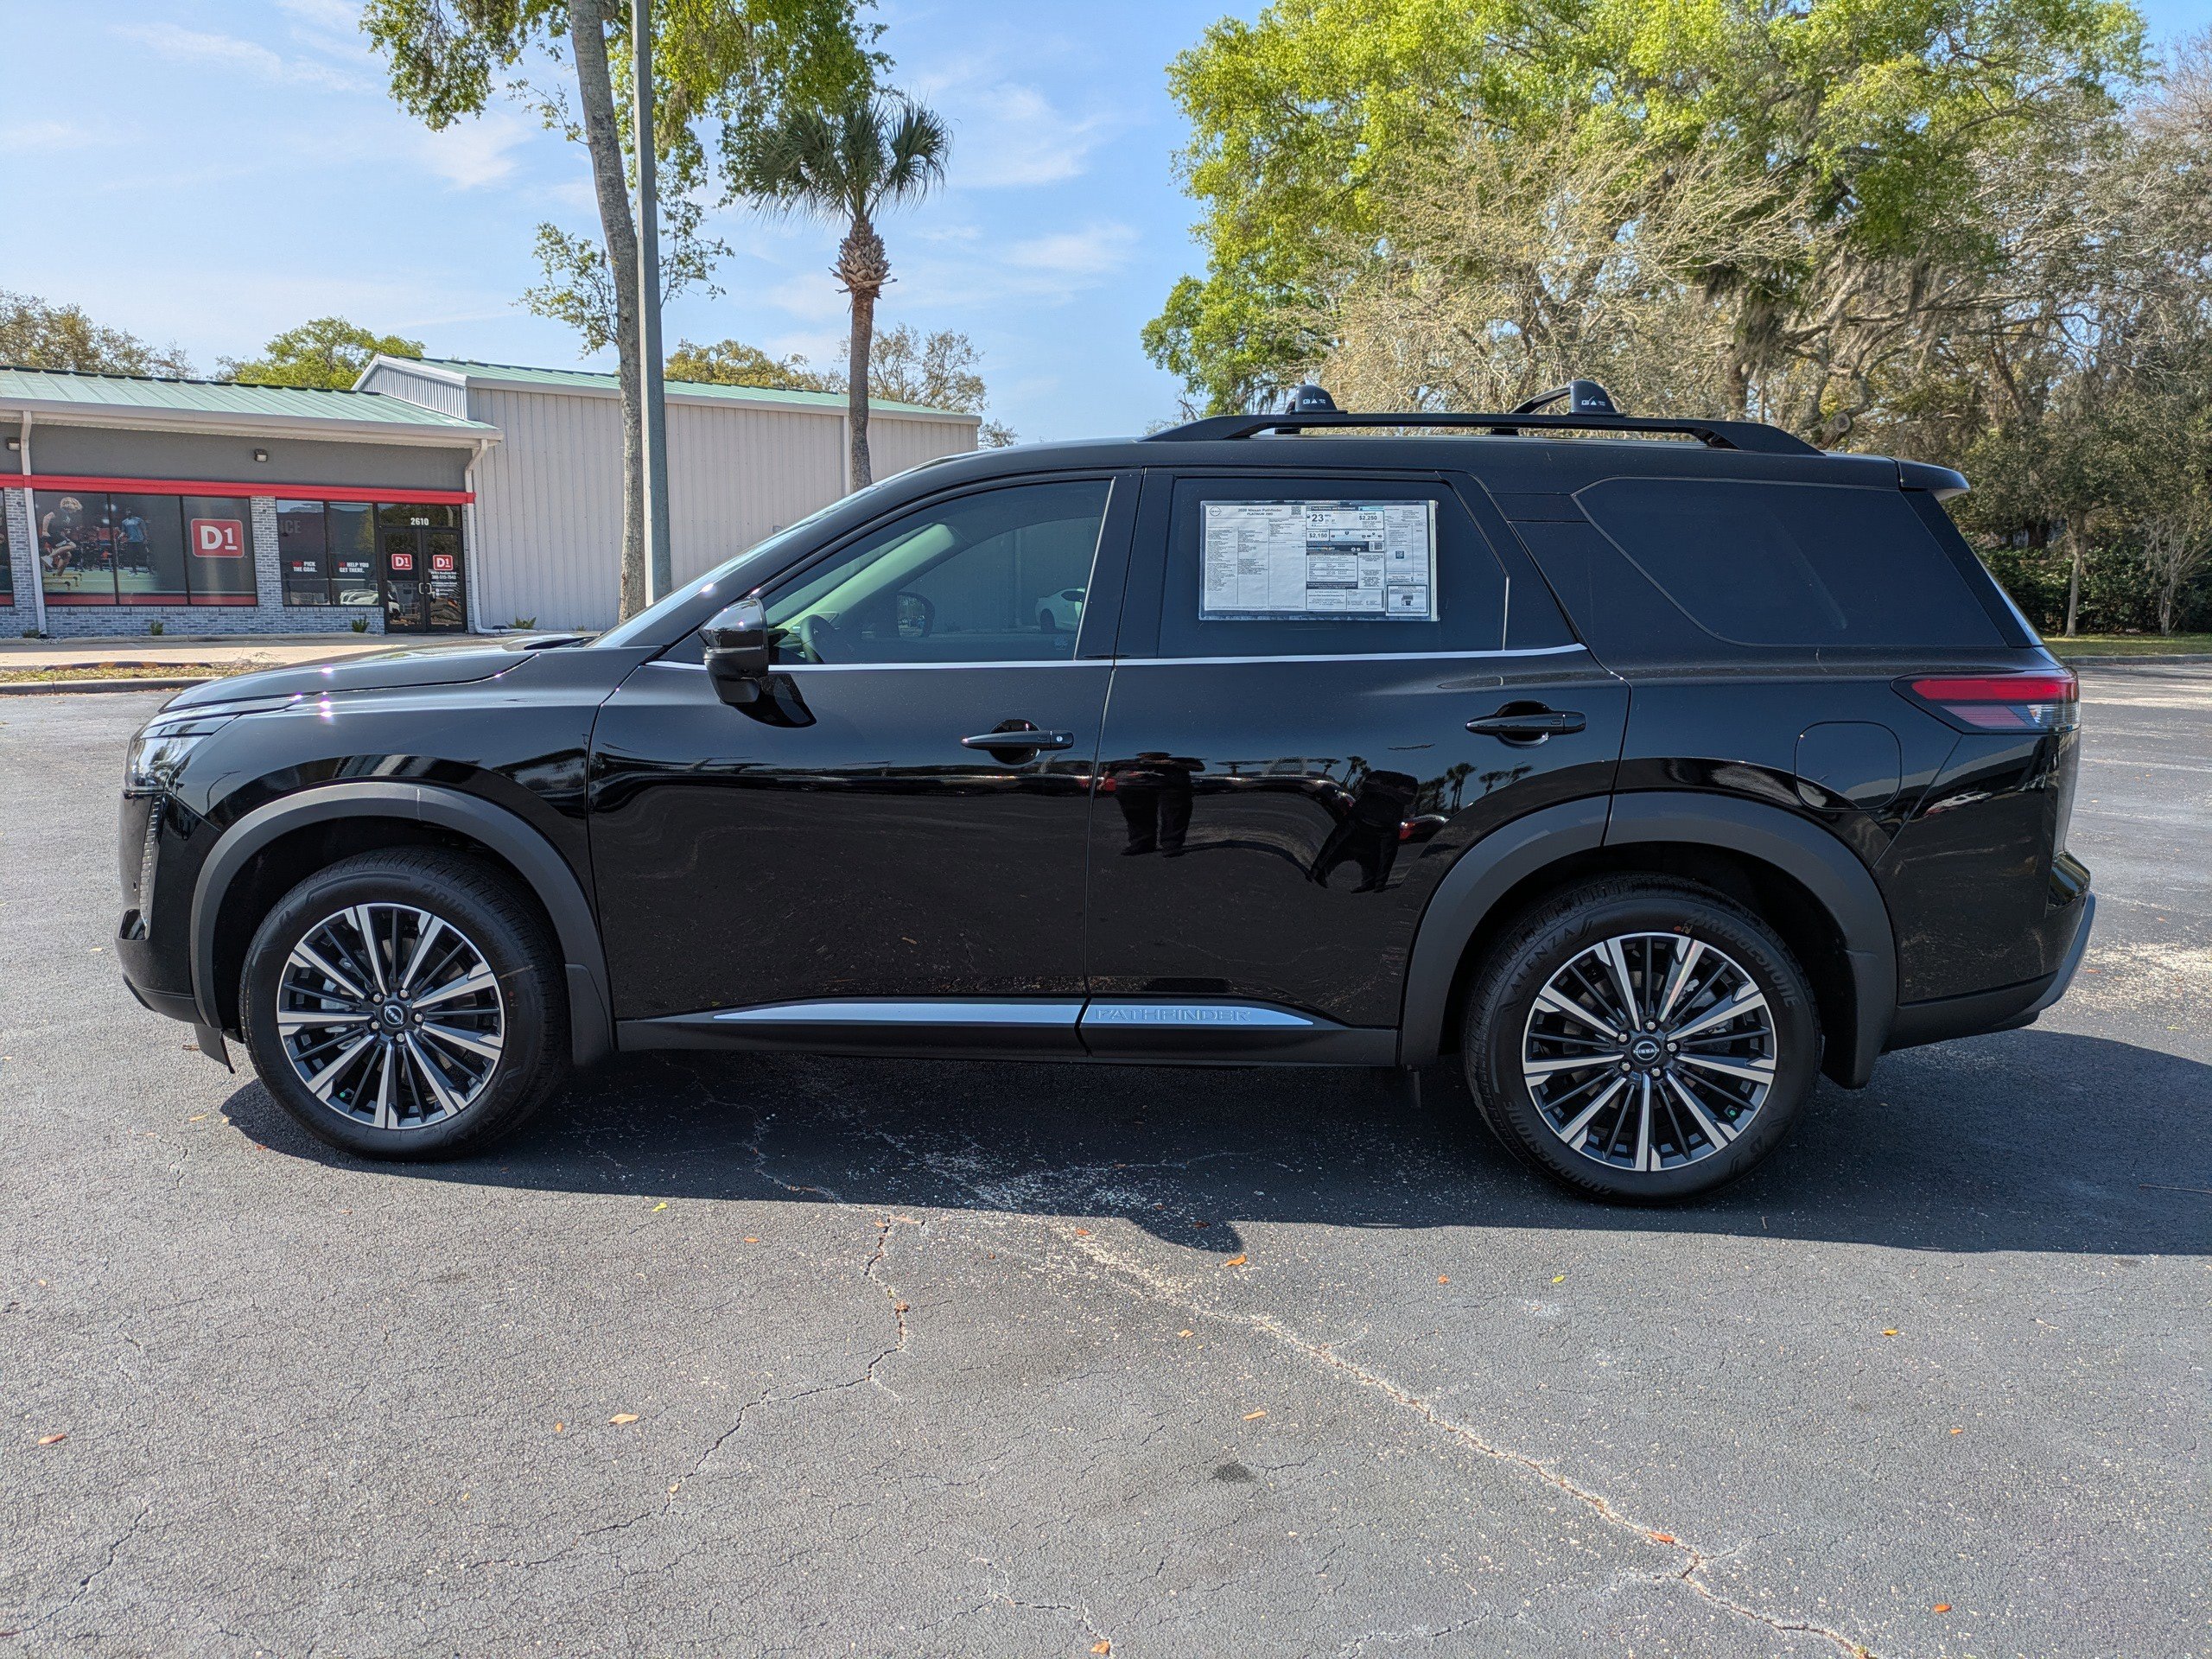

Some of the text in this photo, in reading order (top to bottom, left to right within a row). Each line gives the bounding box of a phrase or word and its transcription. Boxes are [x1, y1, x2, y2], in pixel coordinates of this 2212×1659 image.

[410, 517, 429, 526] 2610
[1312, 513, 1324, 522] 23
[200, 525, 238, 550] D1
[395, 556, 410, 567] D1
[435, 557, 451, 568] D1
[1510, 928, 1574, 995] ALENZA
[1685, 911, 1800, 1007] BRIDGESTONE
[1096, 1009, 1251, 1021] PATHFINDER
